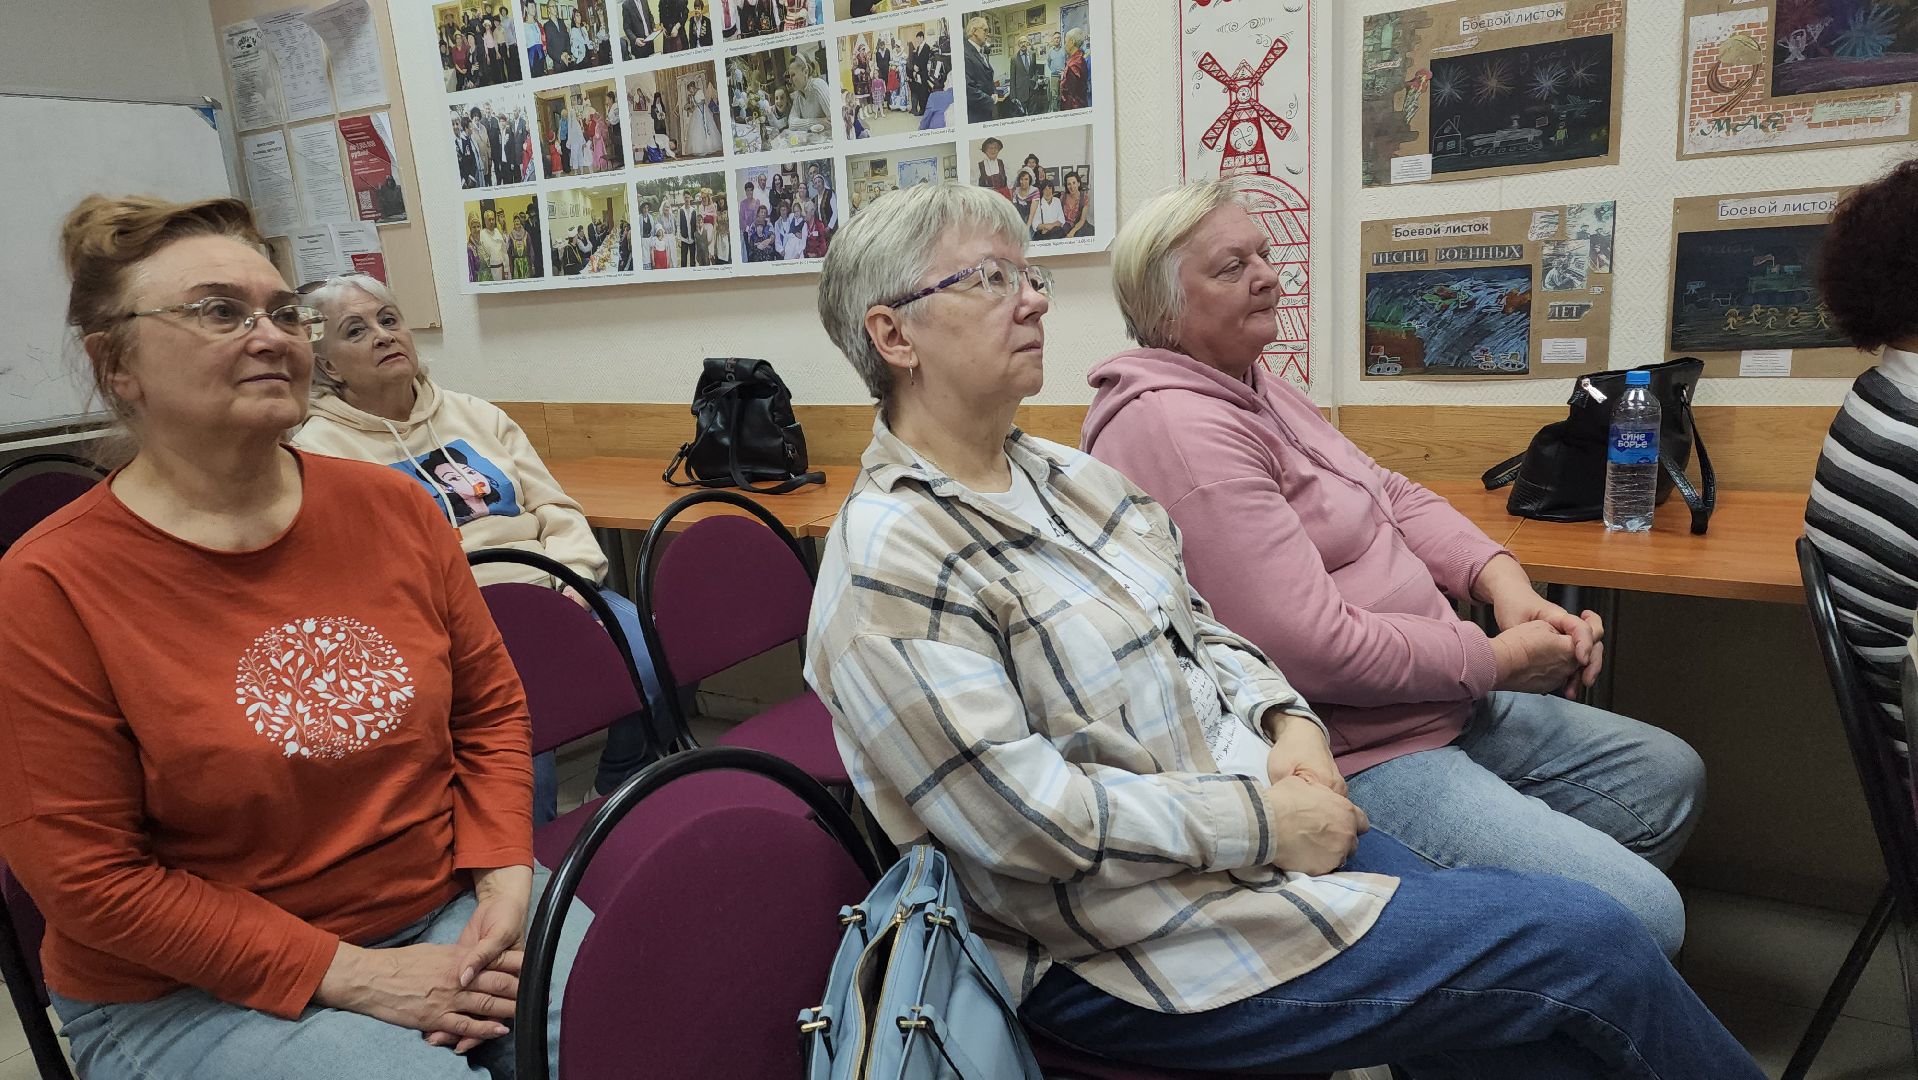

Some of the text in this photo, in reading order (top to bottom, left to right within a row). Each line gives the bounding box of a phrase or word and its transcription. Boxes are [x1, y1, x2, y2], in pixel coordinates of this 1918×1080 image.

[1462, 7, 1563, 31] Боевой листок
[1720, 200, 1837, 216] Боевой листок
[1394, 222, 1489, 238] Боевой листок
[1373, 245, 1521, 264] ПЕСНИ ВОЕННЫХ
[1548, 305, 1581, 318] ЛЕТ
